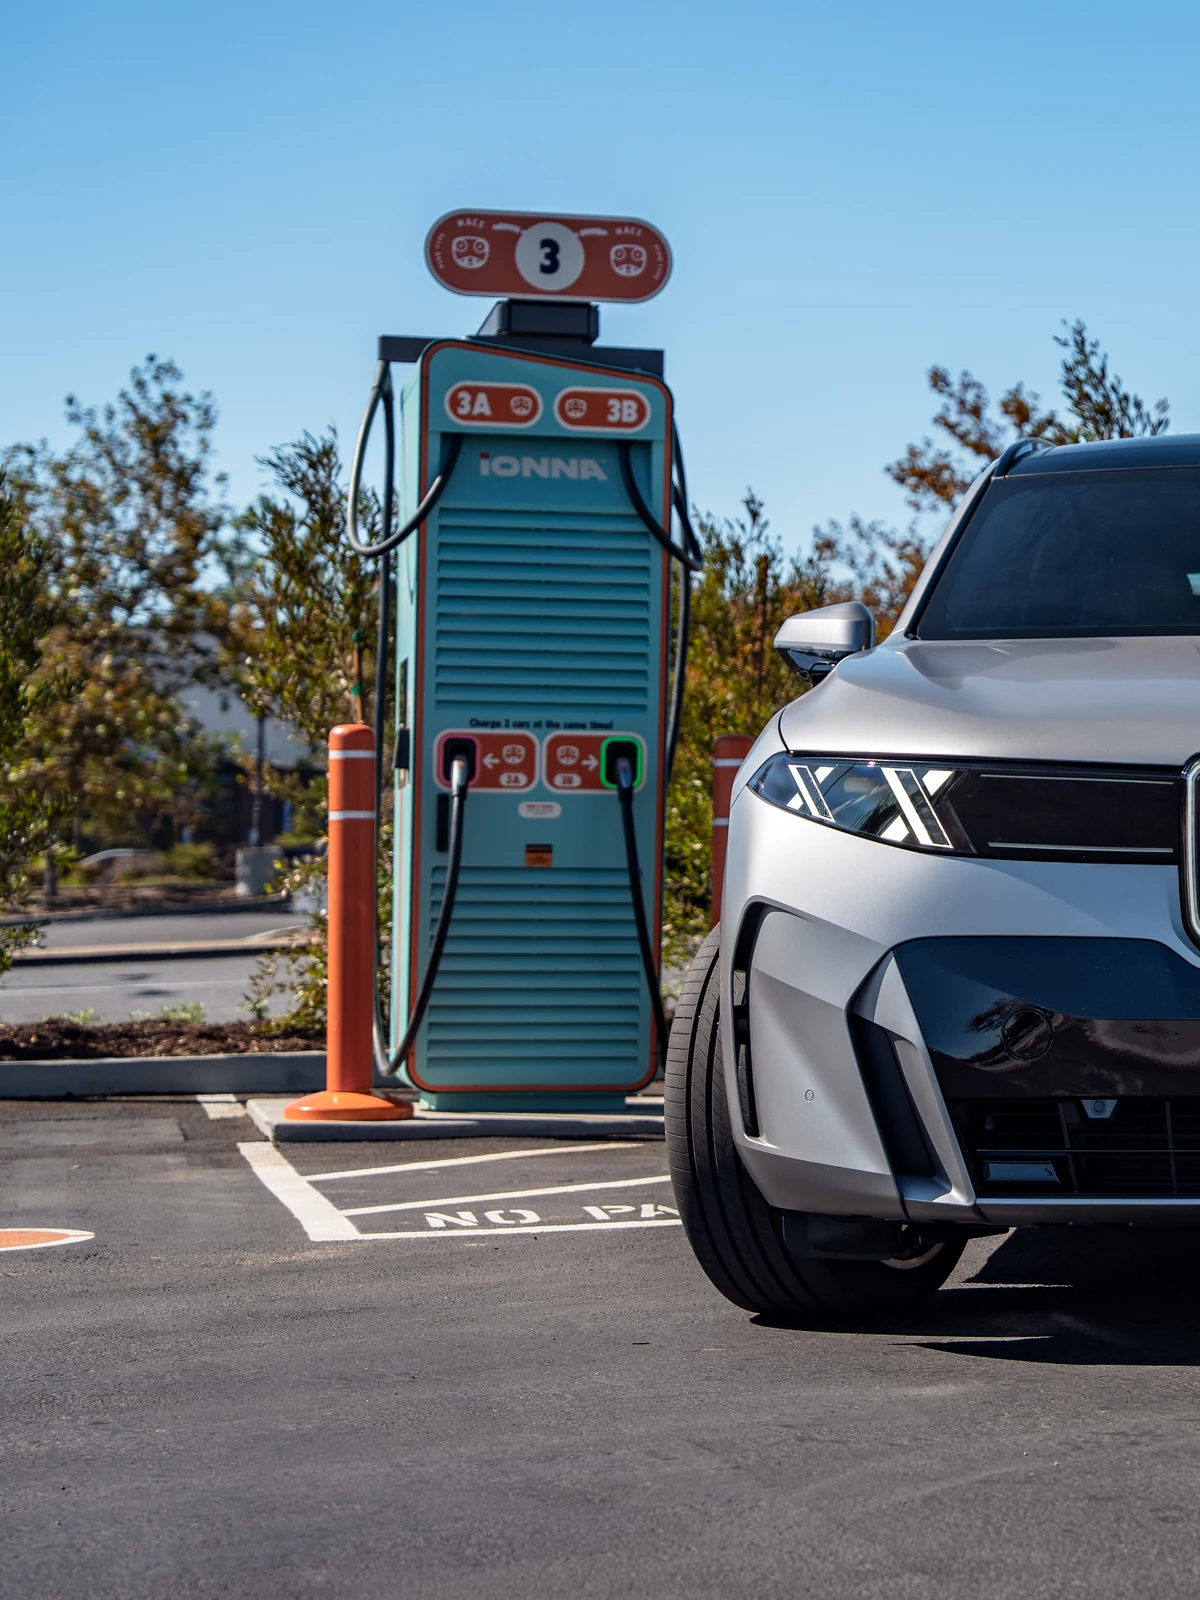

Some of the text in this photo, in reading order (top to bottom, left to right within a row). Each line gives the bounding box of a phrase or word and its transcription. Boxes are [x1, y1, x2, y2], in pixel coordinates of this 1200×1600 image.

[539, 238, 560, 274] 3
[456, 391, 492, 416] 3A
[606, 398, 639, 423] 3B
[469, 718, 501, 729] Charge
[504, 719, 510, 728] 2
[512, 720, 530, 728] cars
[545, 720, 560, 728] the
[563, 721, 587, 729] same
[423, 1209, 542, 1228] NO
